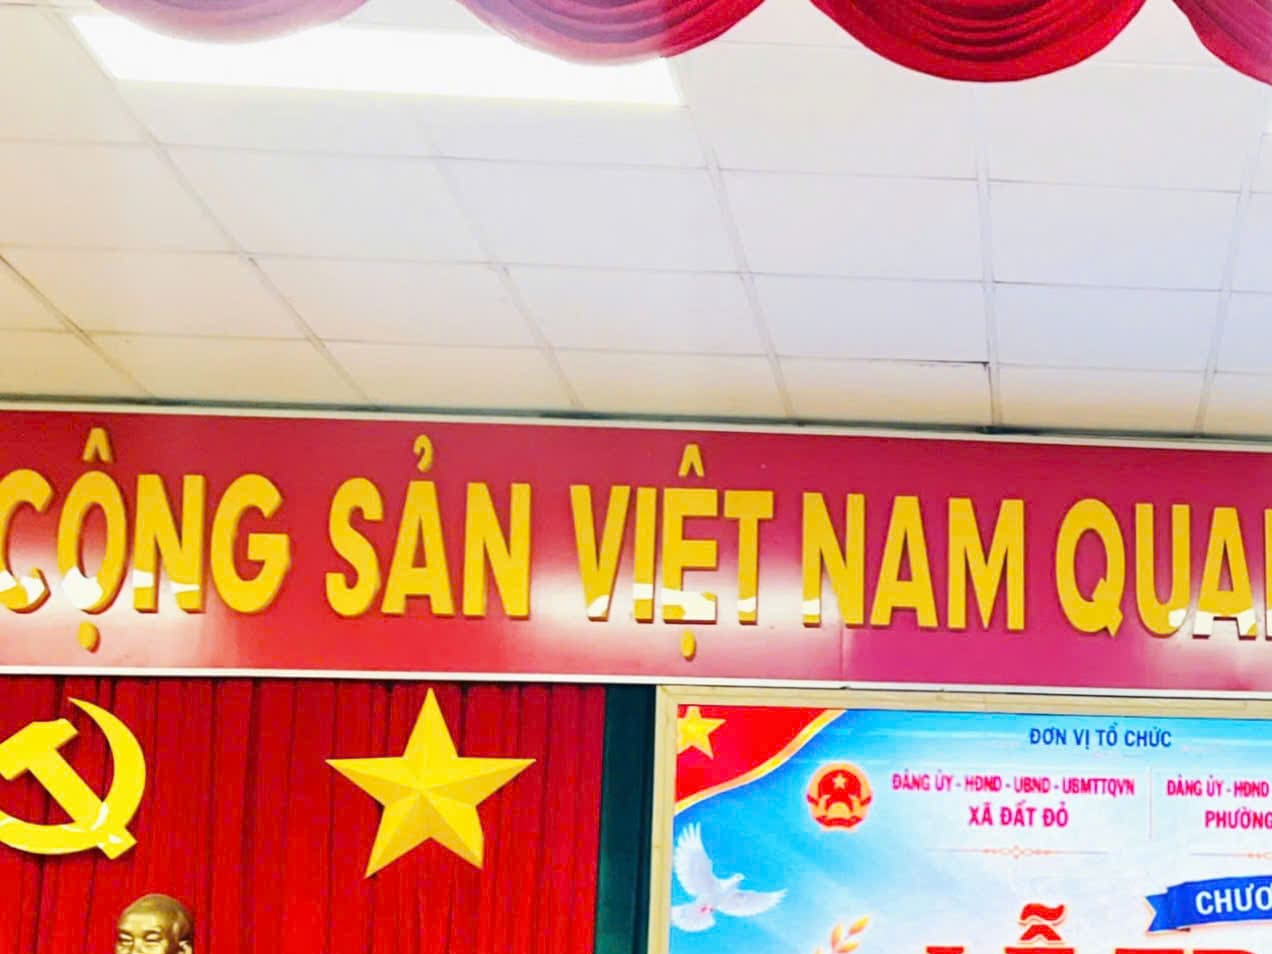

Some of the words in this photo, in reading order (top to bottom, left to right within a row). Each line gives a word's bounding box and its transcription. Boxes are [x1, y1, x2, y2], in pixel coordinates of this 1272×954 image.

[0, 427, 291, 652] CỘNG
[325, 434, 532, 620] SẢN
[570, 444, 774, 661] VIỆT
[801, 492, 1024, 631] NAM
[1030, 726, 1067, 746] ĐƠN
[1073, 729, 1090, 749] VỊ
[1096, 722, 1118, 747] TỔ
[1125, 725, 1172, 748] CHỨC
[892, 769, 931, 791] ĐẢNG
[965, 776, 1002, 792] HĐND
[1014, 776, 1050, 793] UBND
[1167, 774, 1201, 797] ĐẢNG
[1234, 781, 1269, 798] HĐND
[969, 802, 993, 826] XÃ
[1000, 800, 1036, 827] ĐẤT
[1042, 801, 1069, 828] ĐỎ
